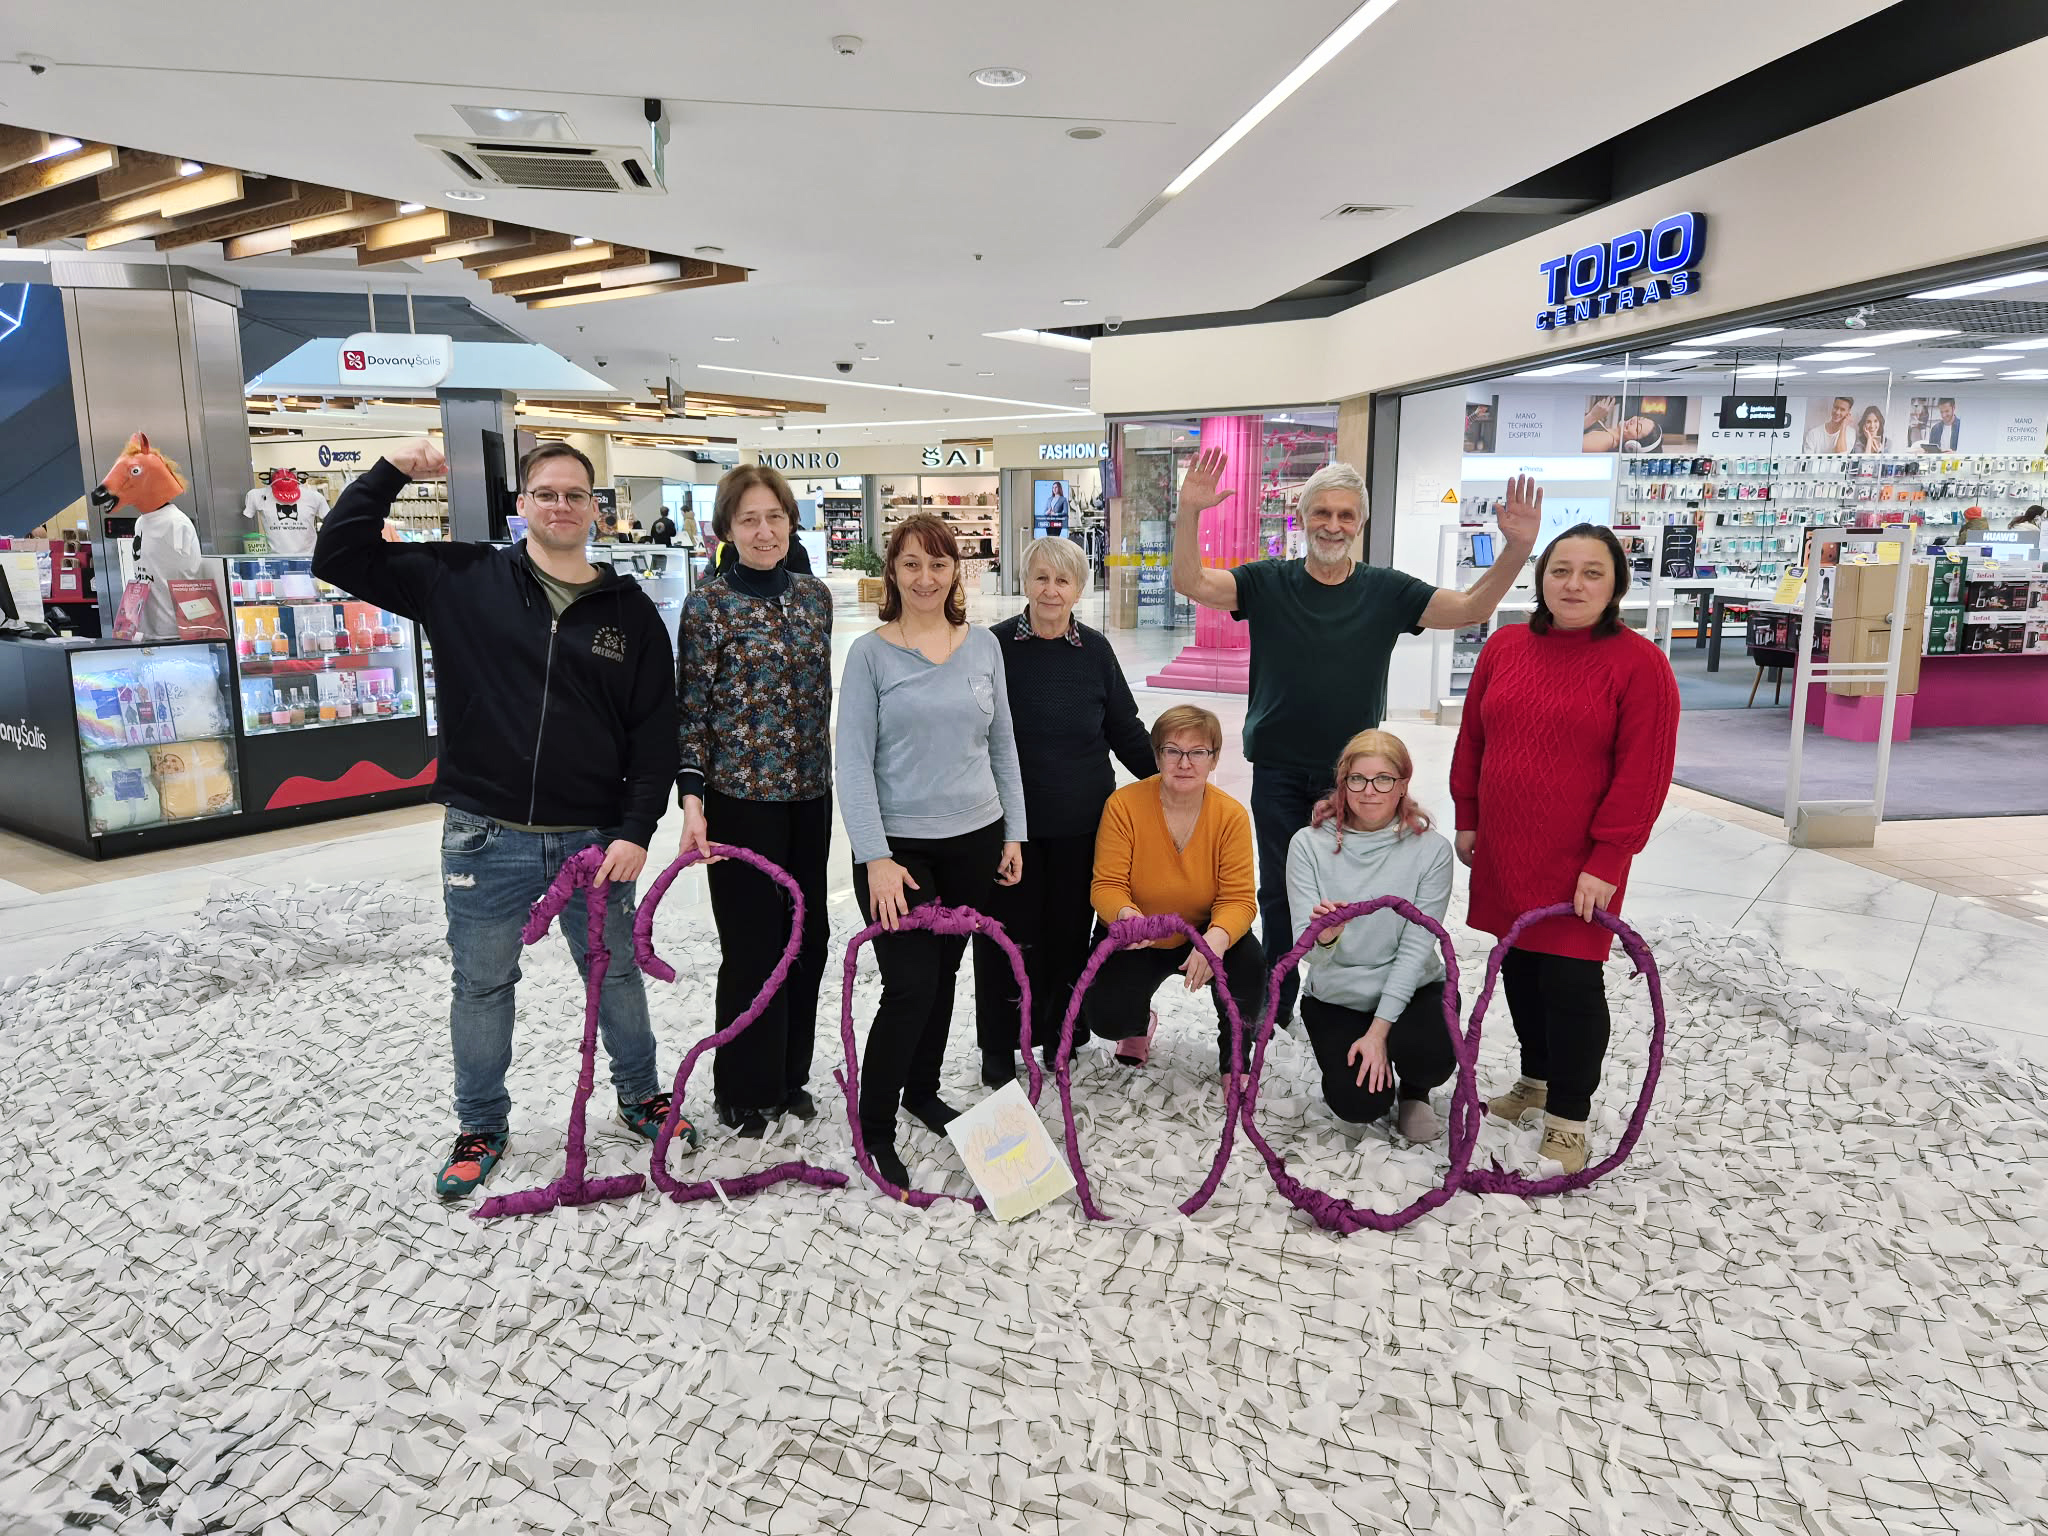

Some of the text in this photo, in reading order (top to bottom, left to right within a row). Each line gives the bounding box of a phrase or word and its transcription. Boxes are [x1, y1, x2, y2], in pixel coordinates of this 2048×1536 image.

[1539, 212, 1700, 305] TOPO
[1536, 271, 1694, 330] CENTRAS
[1508, 431, 1541, 439] EKSPERTAI
[1039, 443, 1096, 459] FASHION
[758, 452, 840, 469] MONRO
[1982, 532, 2019, 542] HUAWEI
